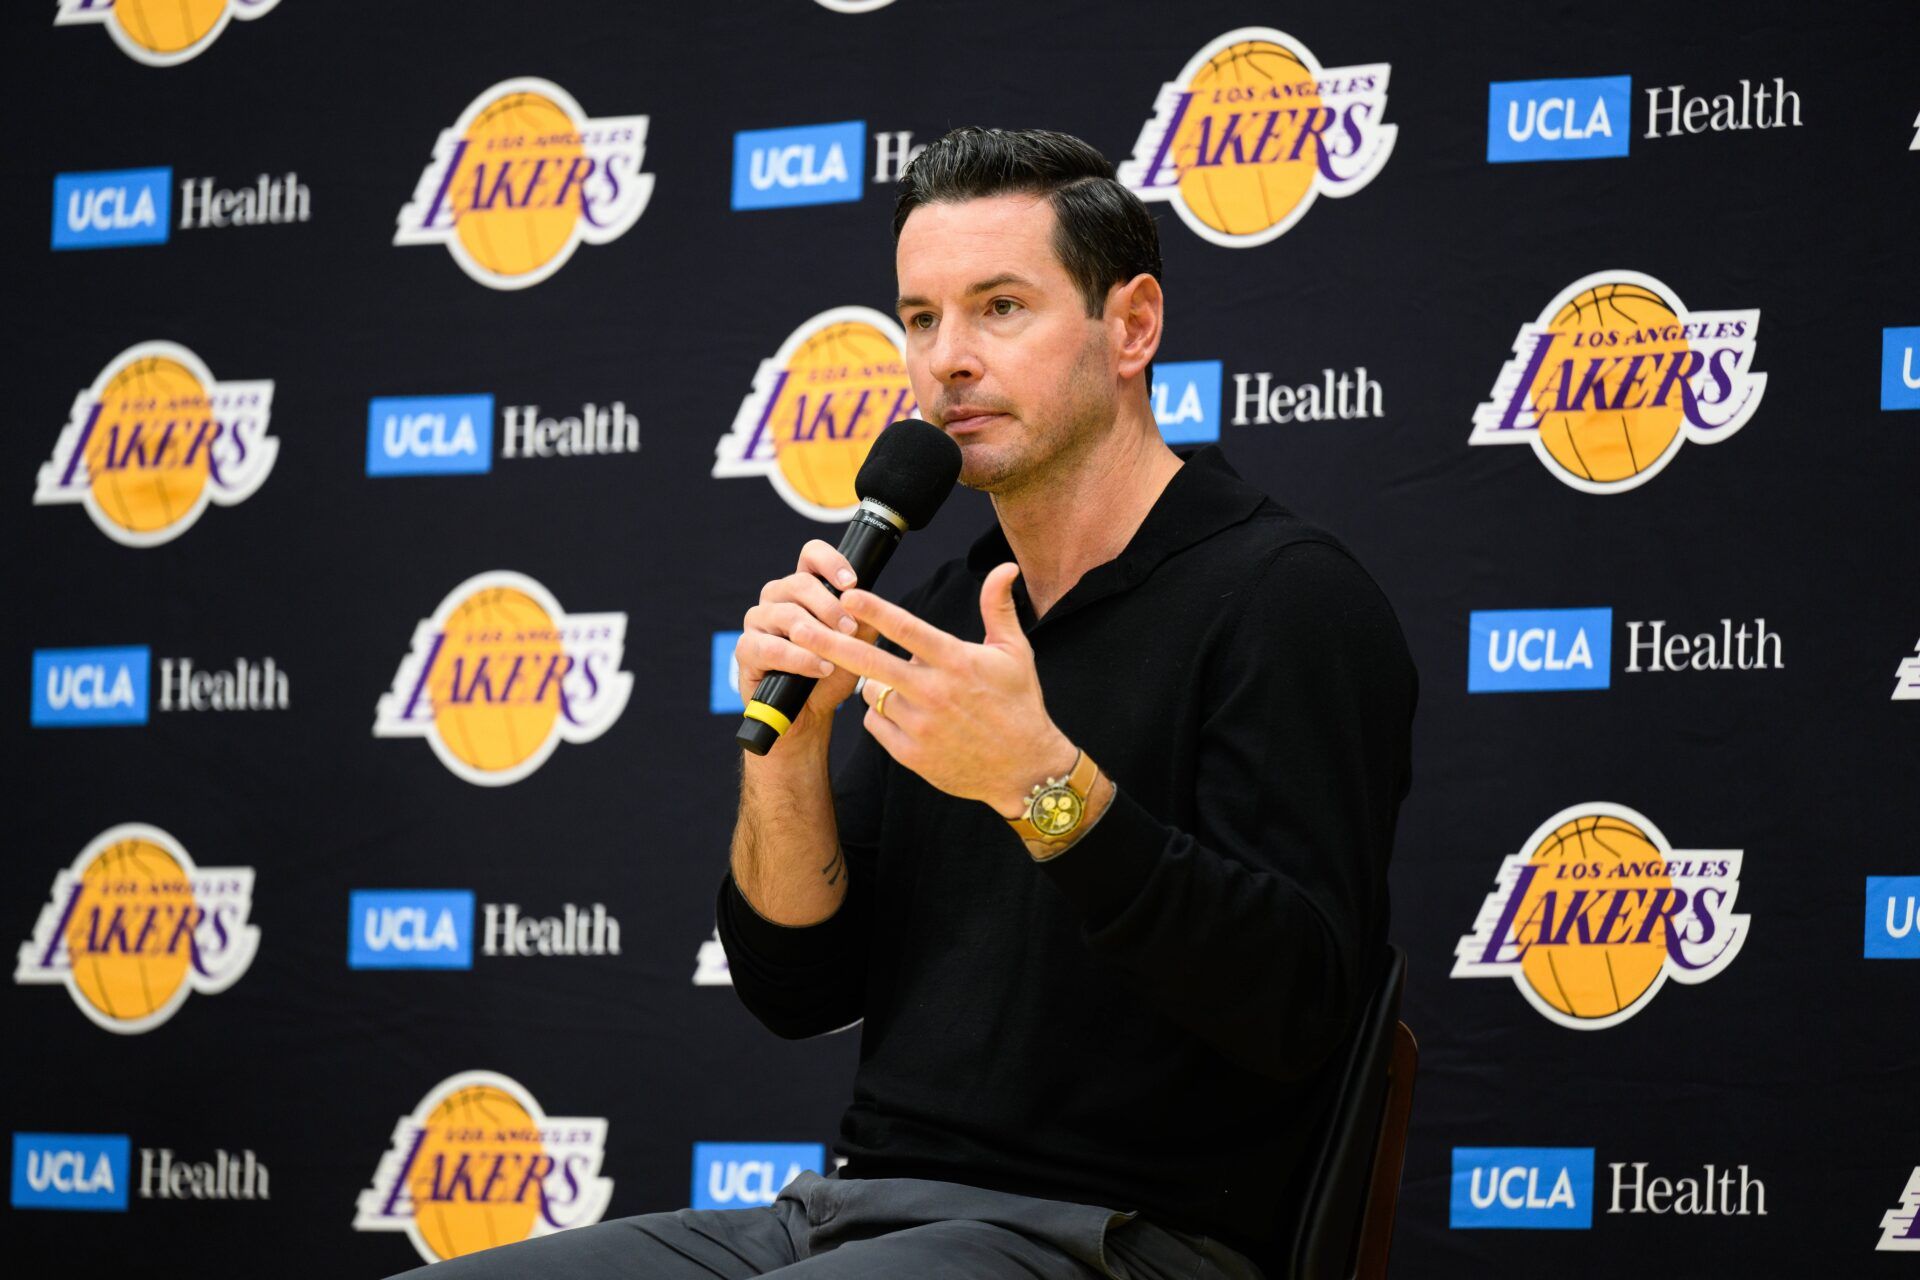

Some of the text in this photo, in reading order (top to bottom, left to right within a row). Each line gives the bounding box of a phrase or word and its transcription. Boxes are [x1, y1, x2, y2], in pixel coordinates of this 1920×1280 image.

[1138, 90, 1380, 183] LAKERS
[1507, 77, 1803, 142] UCLA Health
[749, 142, 849, 191] UCLA
[67, 172, 310, 232] UCLA Health
[1573, 320, 1747, 348] LOS ANGELES
[1151, 366, 1385, 426] LA Health
[1486, 332, 1753, 430] LAKERS
[383, 401, 640, 458] UCLA Health
[1488, 618, 1785, 673] UCLA Health
[46, 657, 289, 711] UCLA Health
[1555, 859, 1731, 880] LOS ANGELES
[364, 903, 620, 956] UCLA Health
[1467, 864, 1737, 971] LAKERS
[26, 1148, 269, 1199] UCLA Health
[1470, 1162, 1768, 1216] UCLA Health
